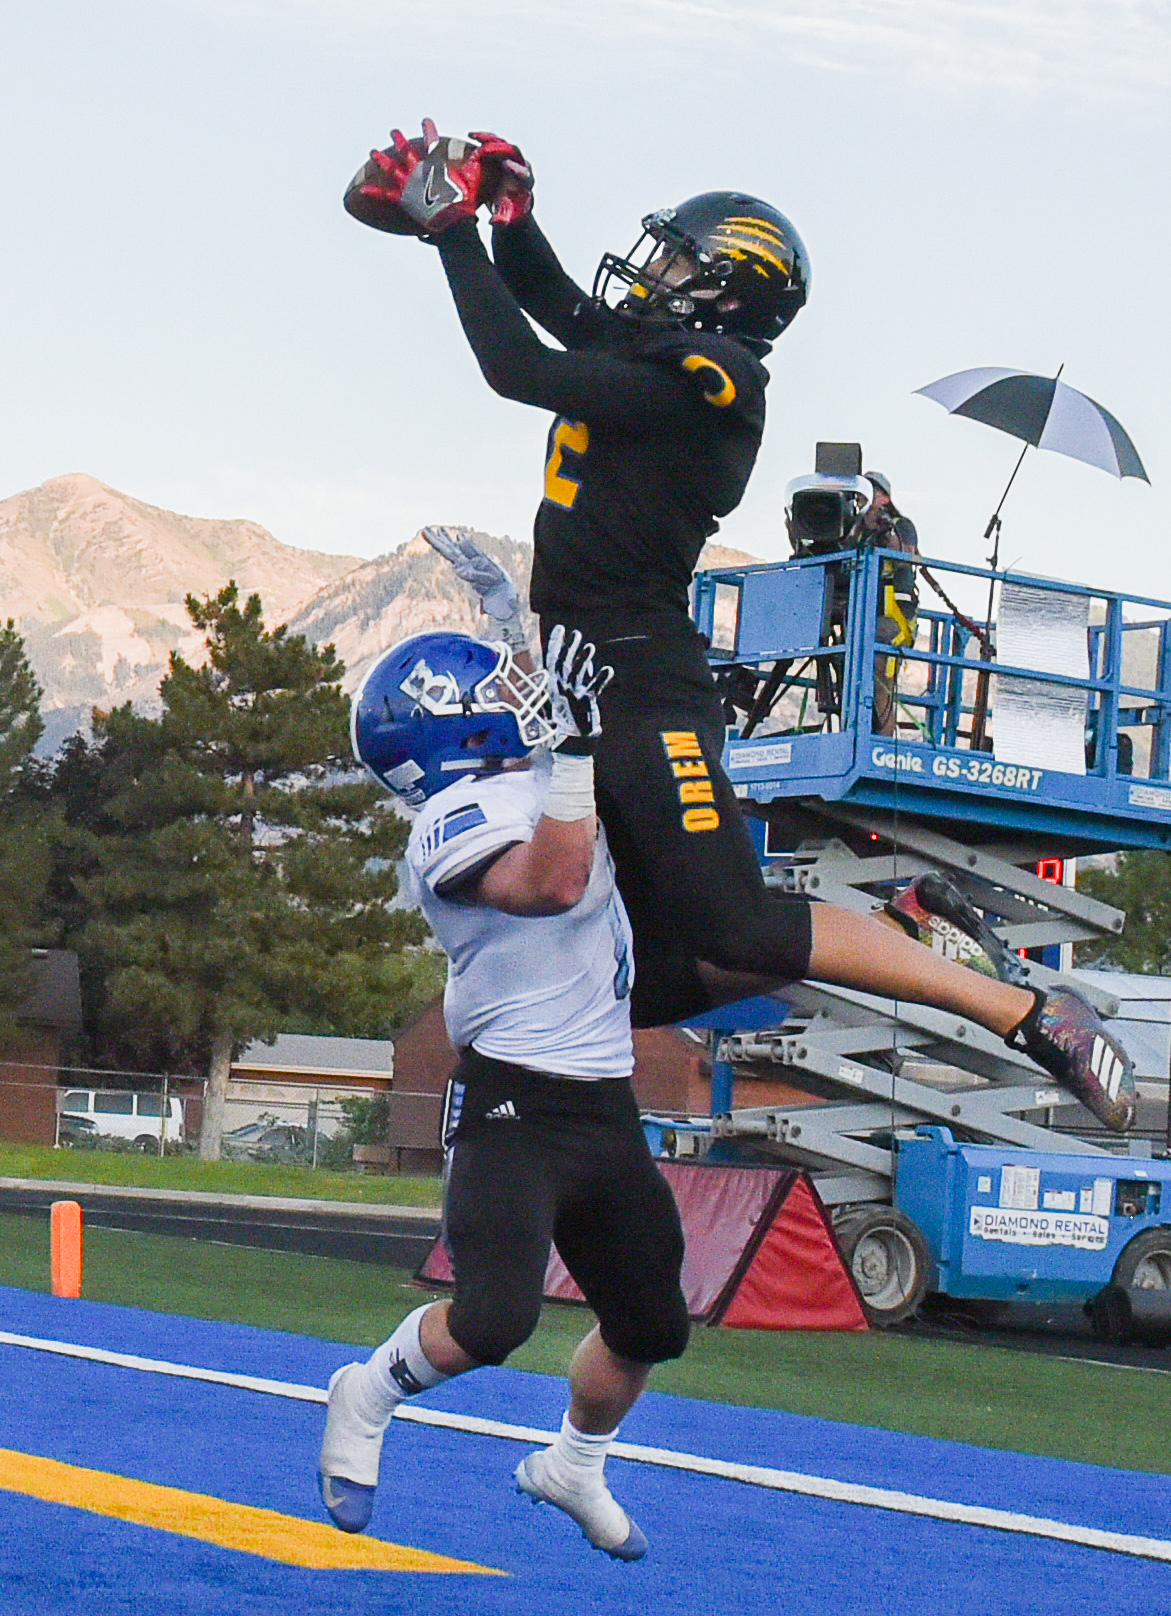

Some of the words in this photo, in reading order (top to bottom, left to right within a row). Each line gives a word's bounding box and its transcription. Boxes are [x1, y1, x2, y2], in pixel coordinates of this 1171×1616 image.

[661, 731, 720, 832] OREM
[871, 747, 923, 773] Genie
[932, 756, 1043, 790] GS-3268RT
[928, 916, 983, 957] adidas
[984, 1214, 1050, 1231] DIAMOND
[1055, 1219, 1105, 1235] RENTAL
